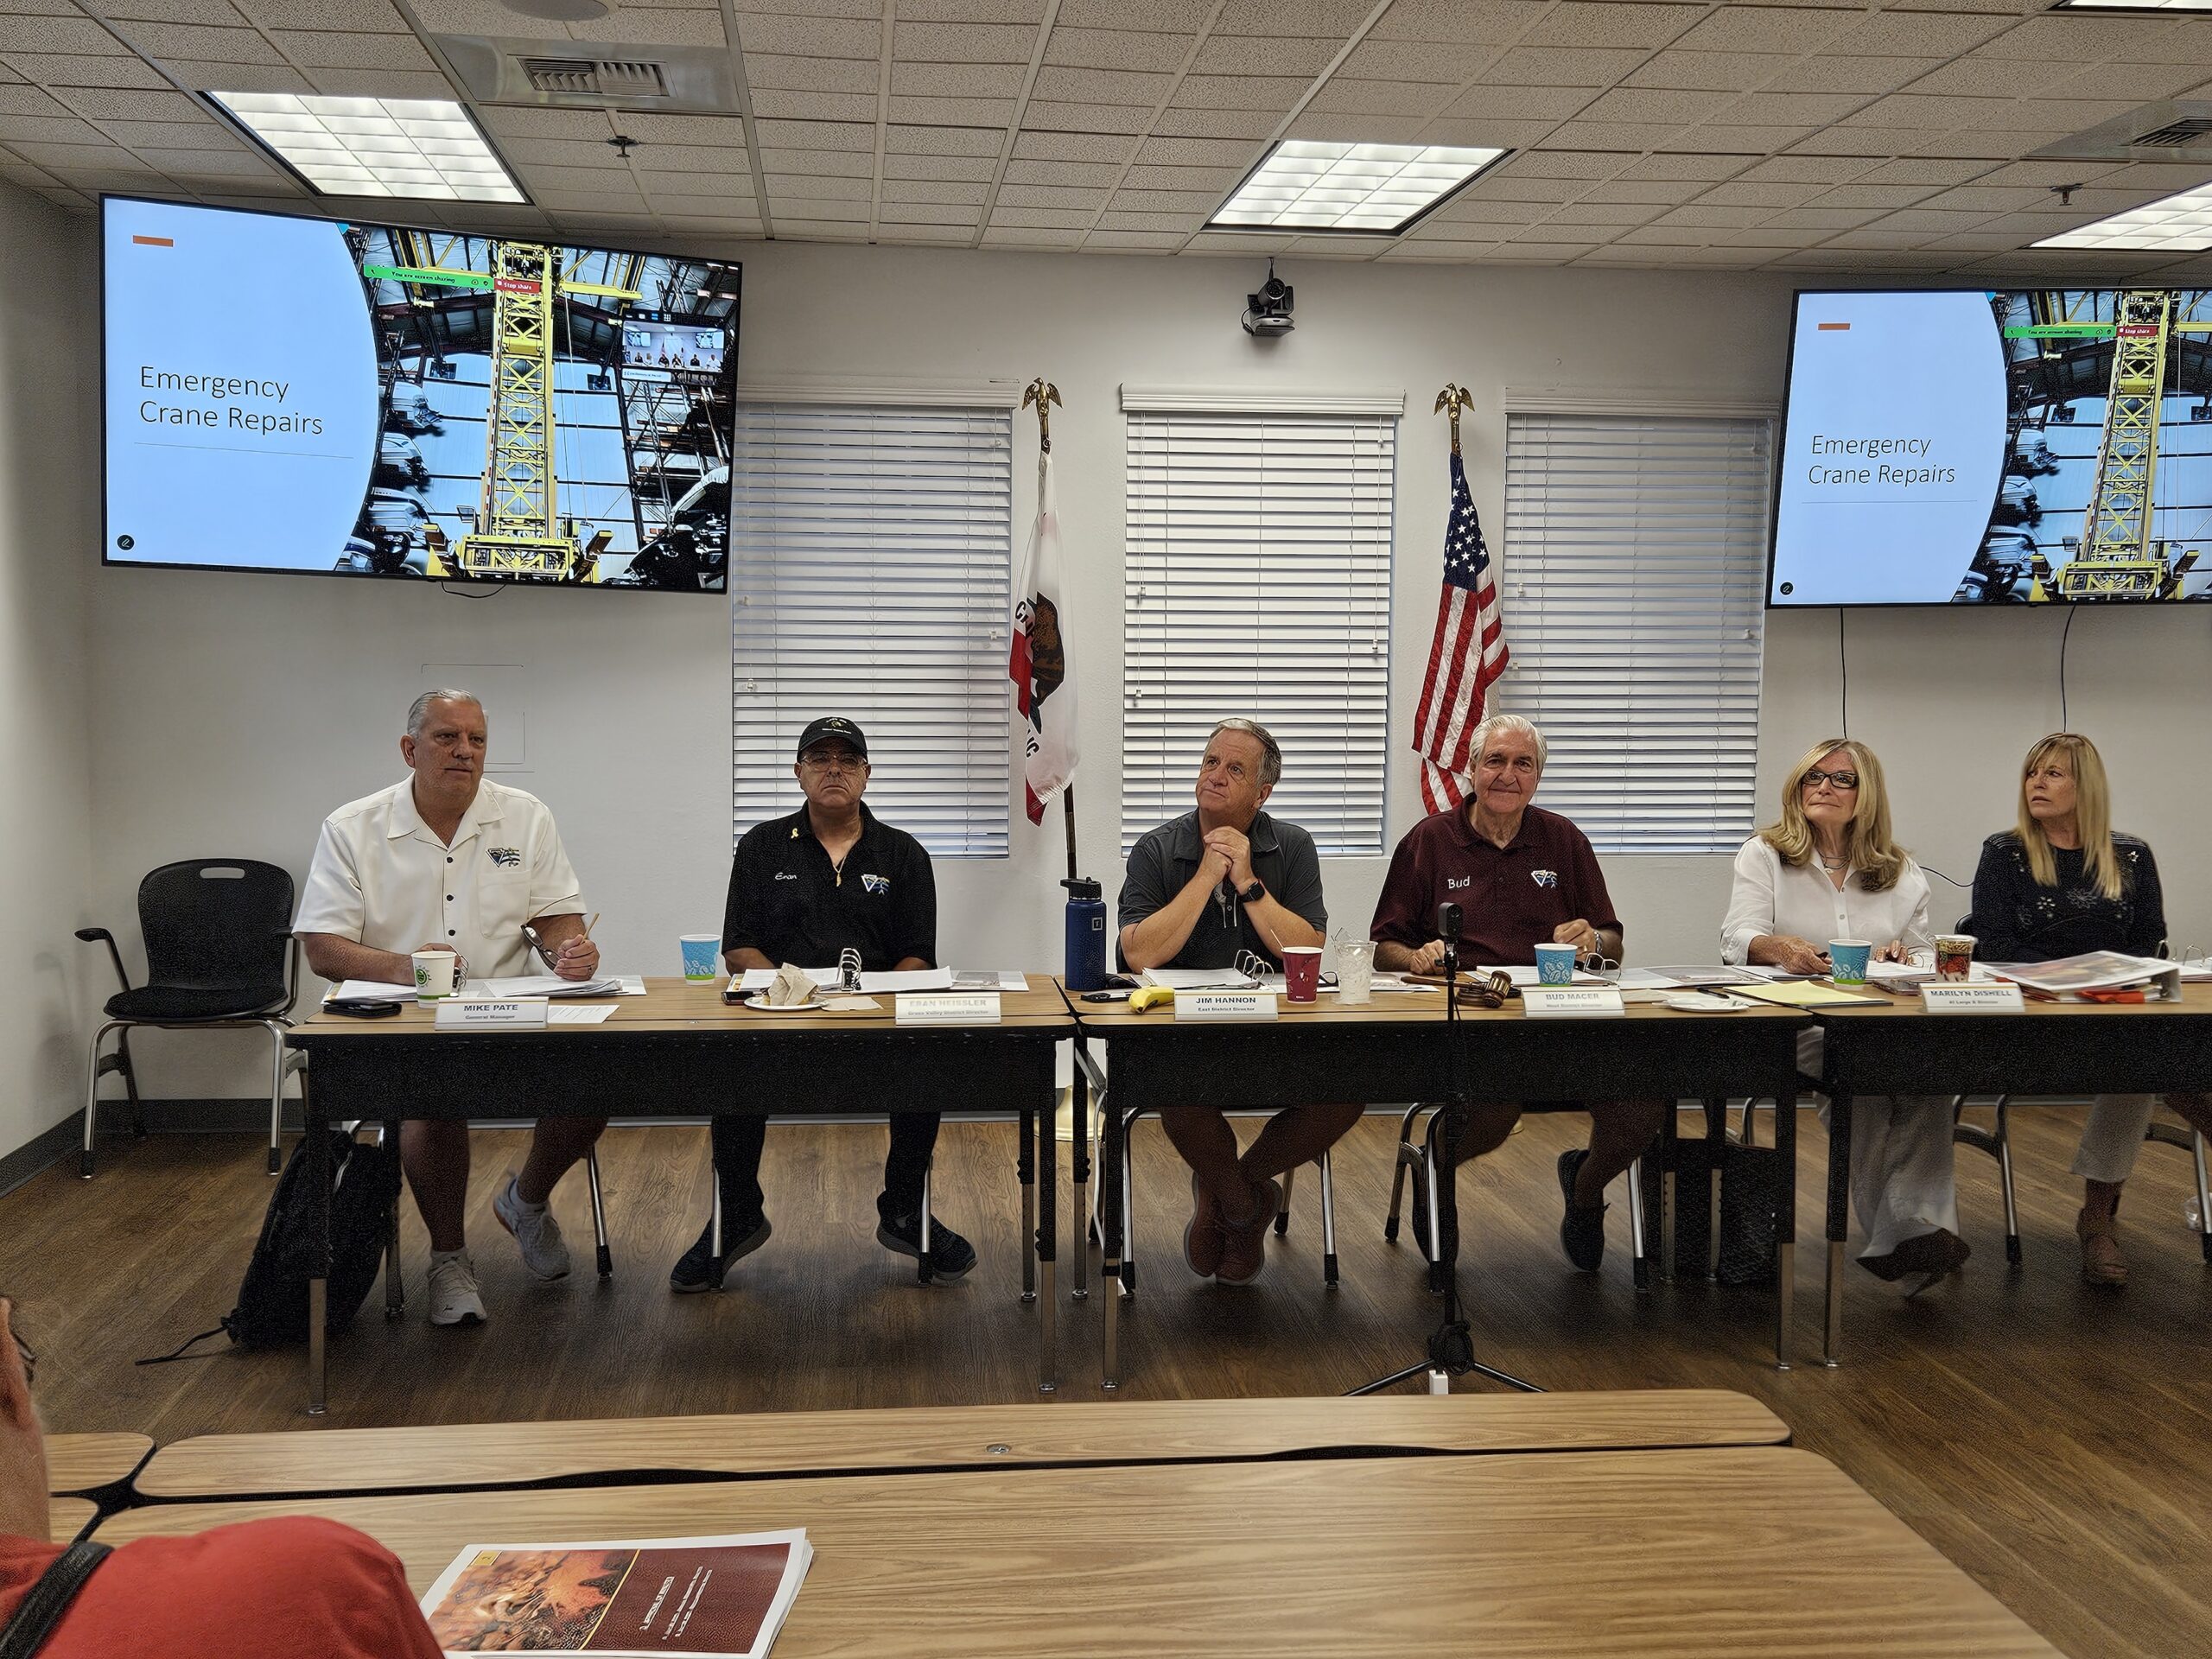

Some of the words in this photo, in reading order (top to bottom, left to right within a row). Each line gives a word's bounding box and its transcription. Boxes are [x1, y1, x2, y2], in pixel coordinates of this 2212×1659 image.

[434, 275, 455, 283] sharing
[504, 282, 517, 290] Stop
[140, 365, 289, 404] Emergency
[140, 400, 219, 428] Crane
[228, 406, 323, 435] Repairs
[1811, 435, 1932, 459] Emergency
[1808, 465, 1871, 484] Crane
[1878, 463, 1956, 487] Repairs
[774, 872, 798, 880] Eran
[1447, 875, 1471, 889] Bud
